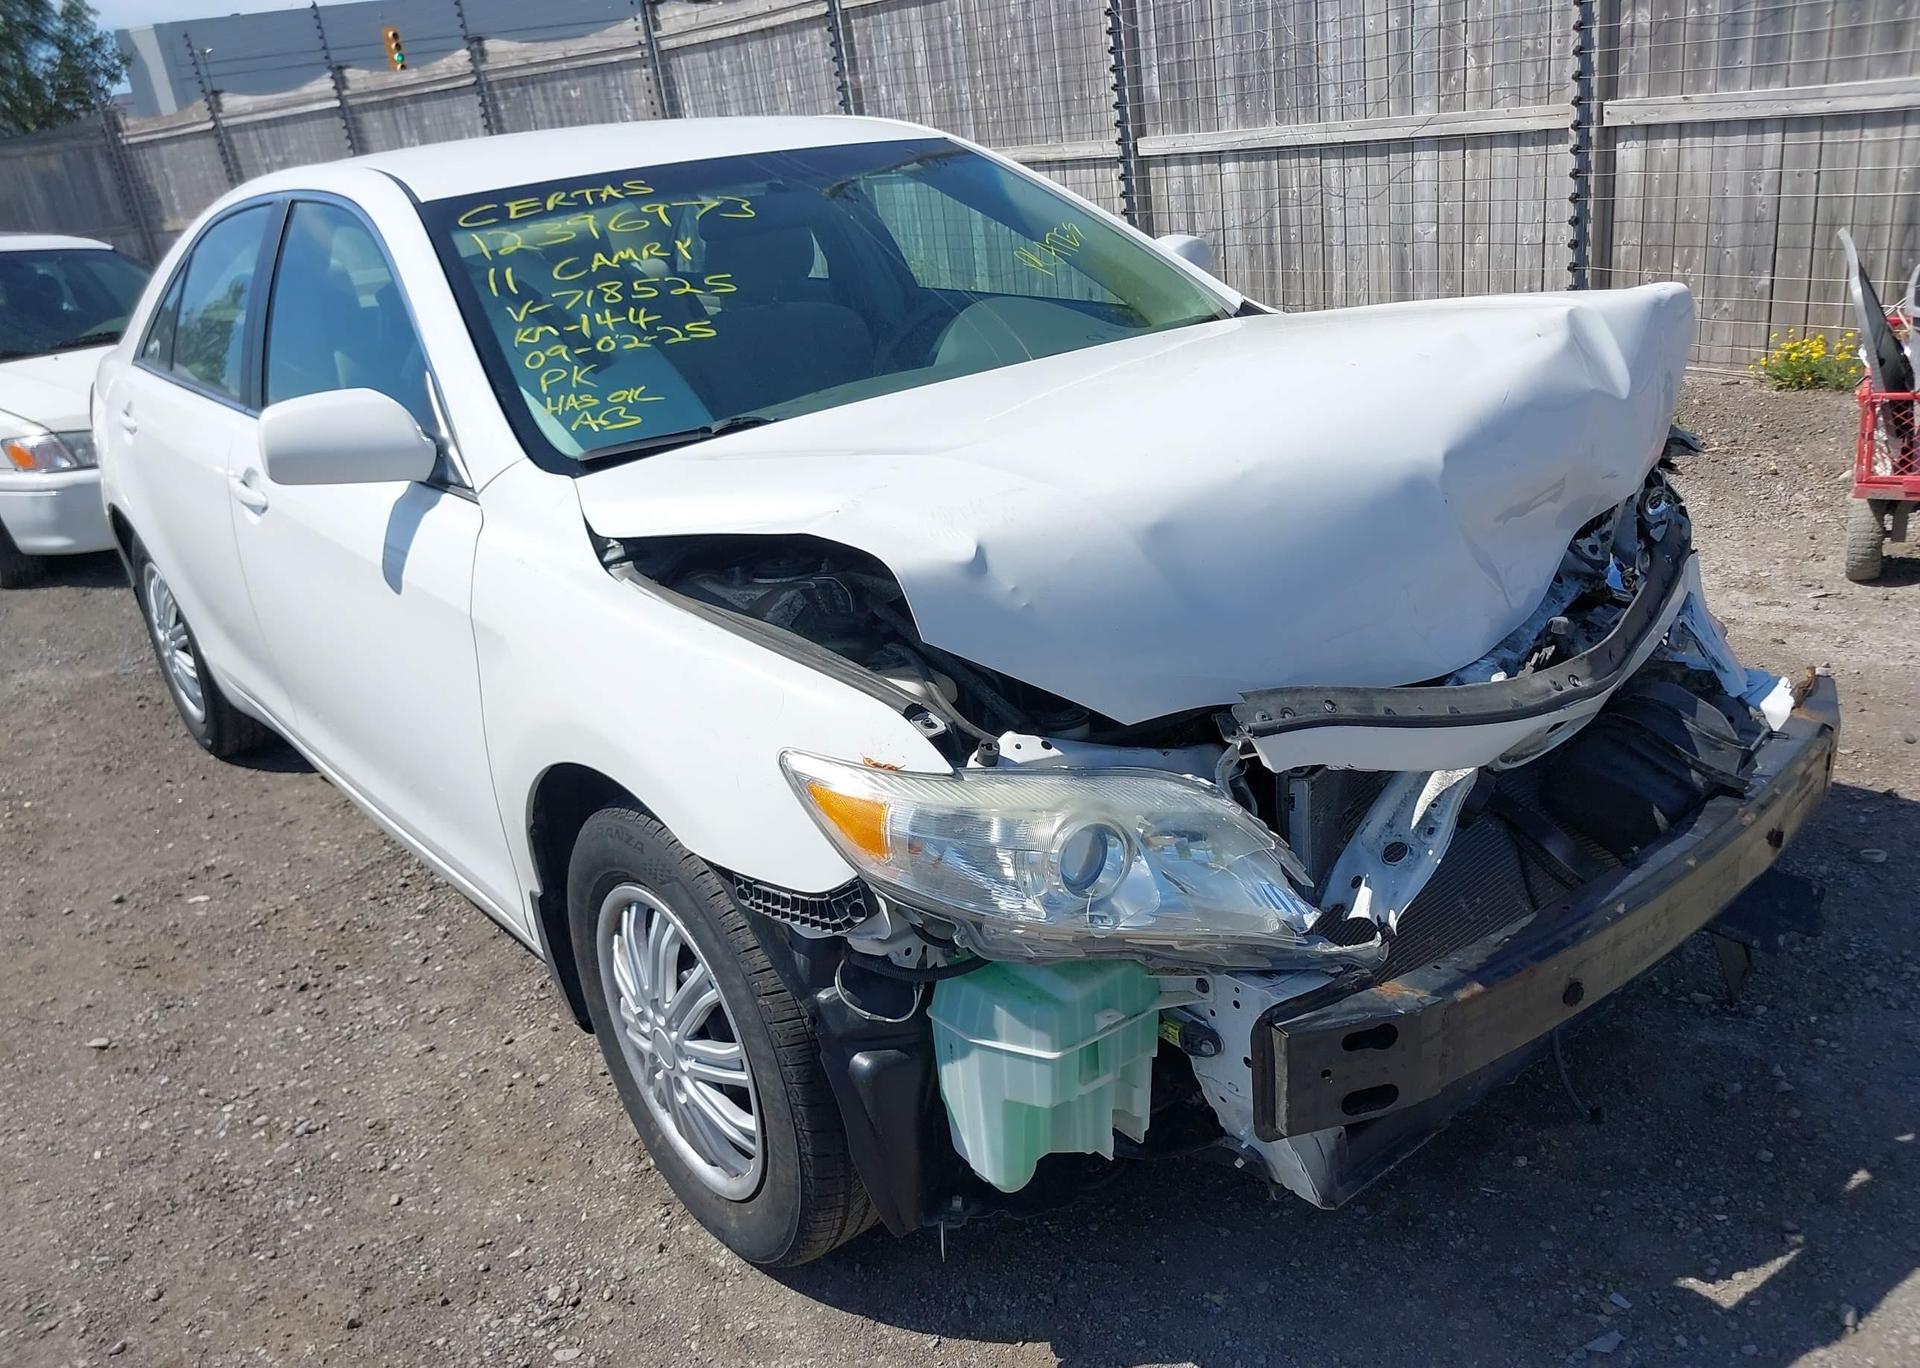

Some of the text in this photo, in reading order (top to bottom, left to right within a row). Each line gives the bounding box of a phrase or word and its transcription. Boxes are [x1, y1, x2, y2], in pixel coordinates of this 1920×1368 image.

[458, 180, 655, 228] CERTAS
[471, 195, 757, 262] 12396973
[488, 237, 693, 297] 11 CAMRY
[524, 320, 718, 370] 09-02-25
[539, 363, 599, 395] PK
[545, 394, 601, 416] HAS
